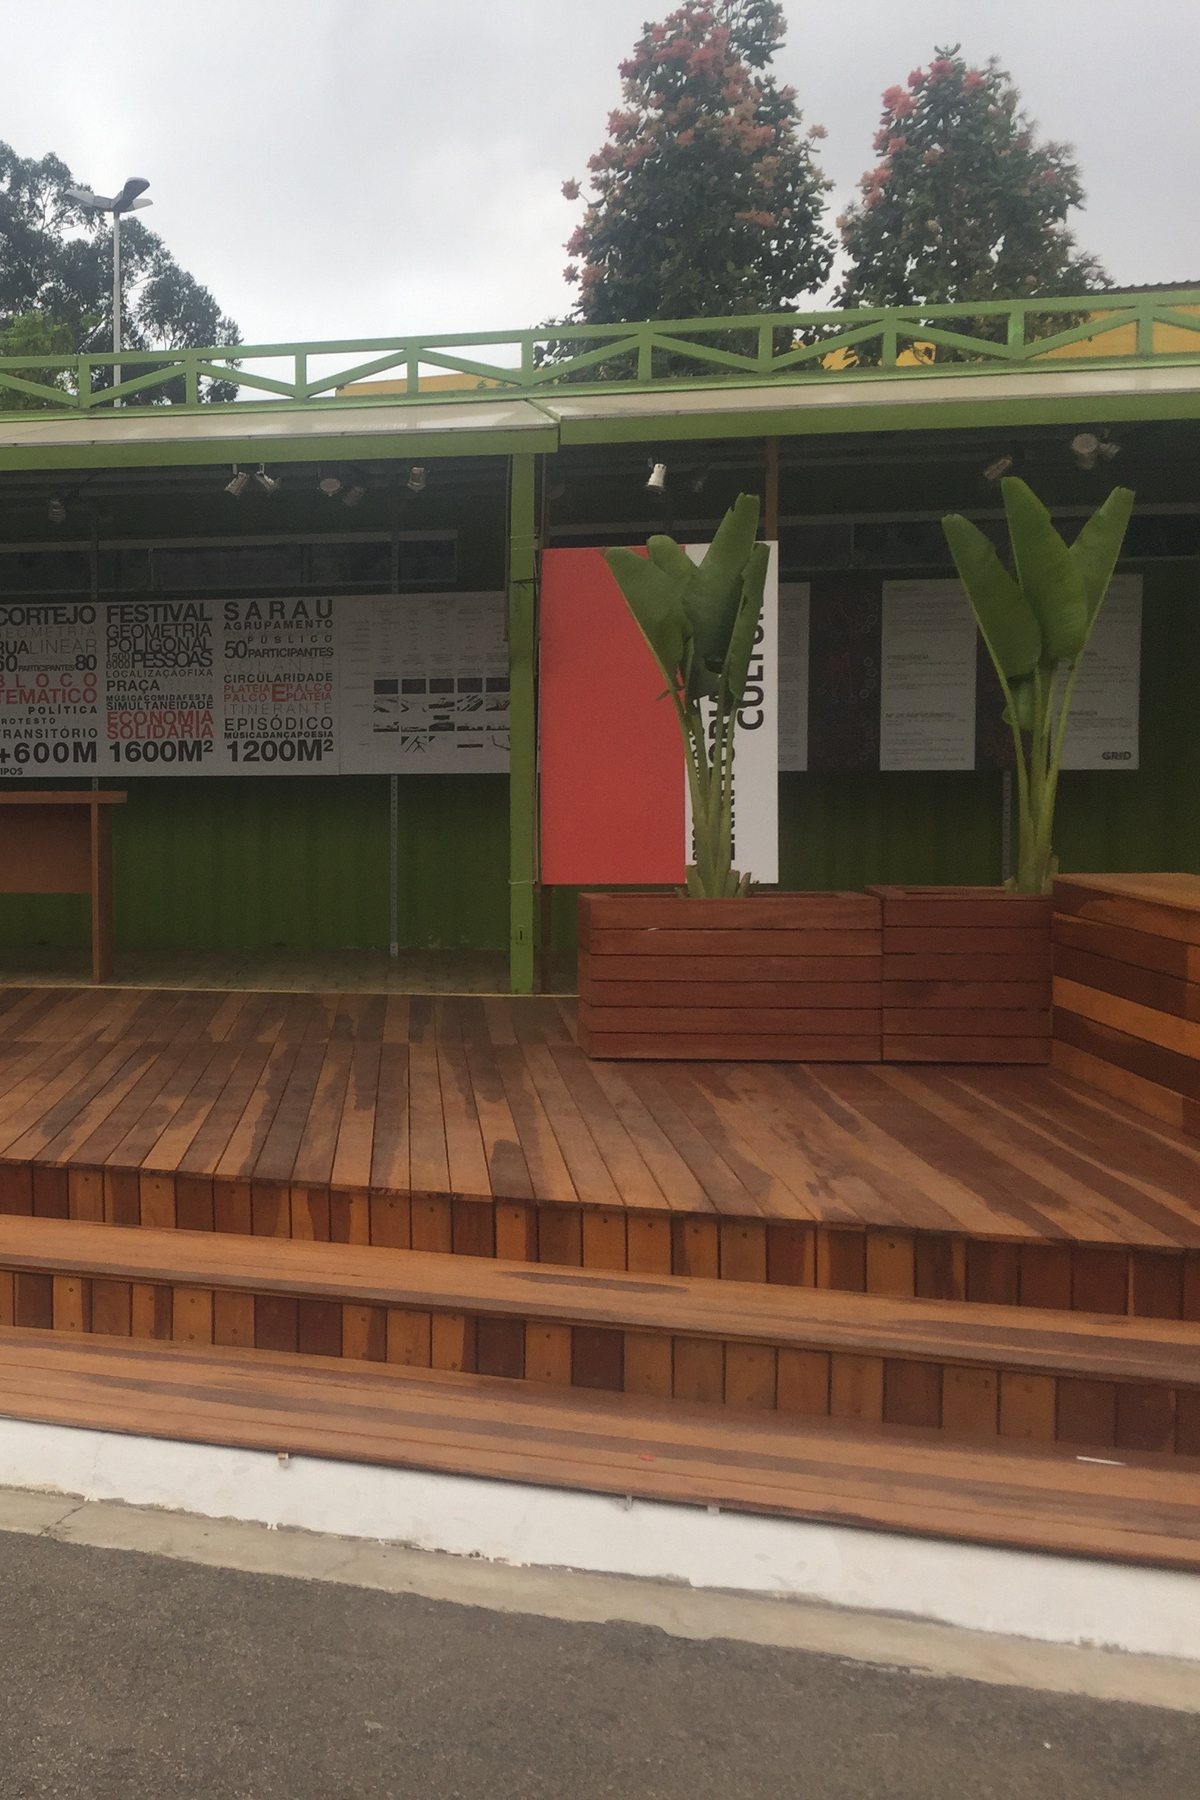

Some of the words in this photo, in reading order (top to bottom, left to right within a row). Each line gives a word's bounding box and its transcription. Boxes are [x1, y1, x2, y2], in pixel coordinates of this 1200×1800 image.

[106, 603, 212, 623] FESTIVAL
[224, 600, 333, 621] SARAU
[106, 623, 212, 639] GEOMETRIA
[224, 620, 333, 631] AGRUPAMENTO
[106, 636, 213, 652] POLIGONAL
[224, 640, 247, 659] 50
[248, 647, 334, 658] PARTICIPANTES
[131, 651, 213, 668] PESSOAS
[224, 672, 333, 683] CIRCULARIDADE
[106, 679, 160, 694] PRAÇA
[224, 684, 270, 693] PLATEIA
[272, 683, 287, 702] E
[287, 683, 333, 692] PALCO
[224, 693, 267, 703] PALCO
[287, 692, 332, 701] PLATEIA
[28, 704, 97, 714] POLÍTICA
[106, 700, 214, 711] SIMULTANEIDADE
[224, 702, 332, 715] ITINERANTE
[107, 711, 214, 726] ECONOMIA
[224, 714, 333, 731] EPISÓDICO
